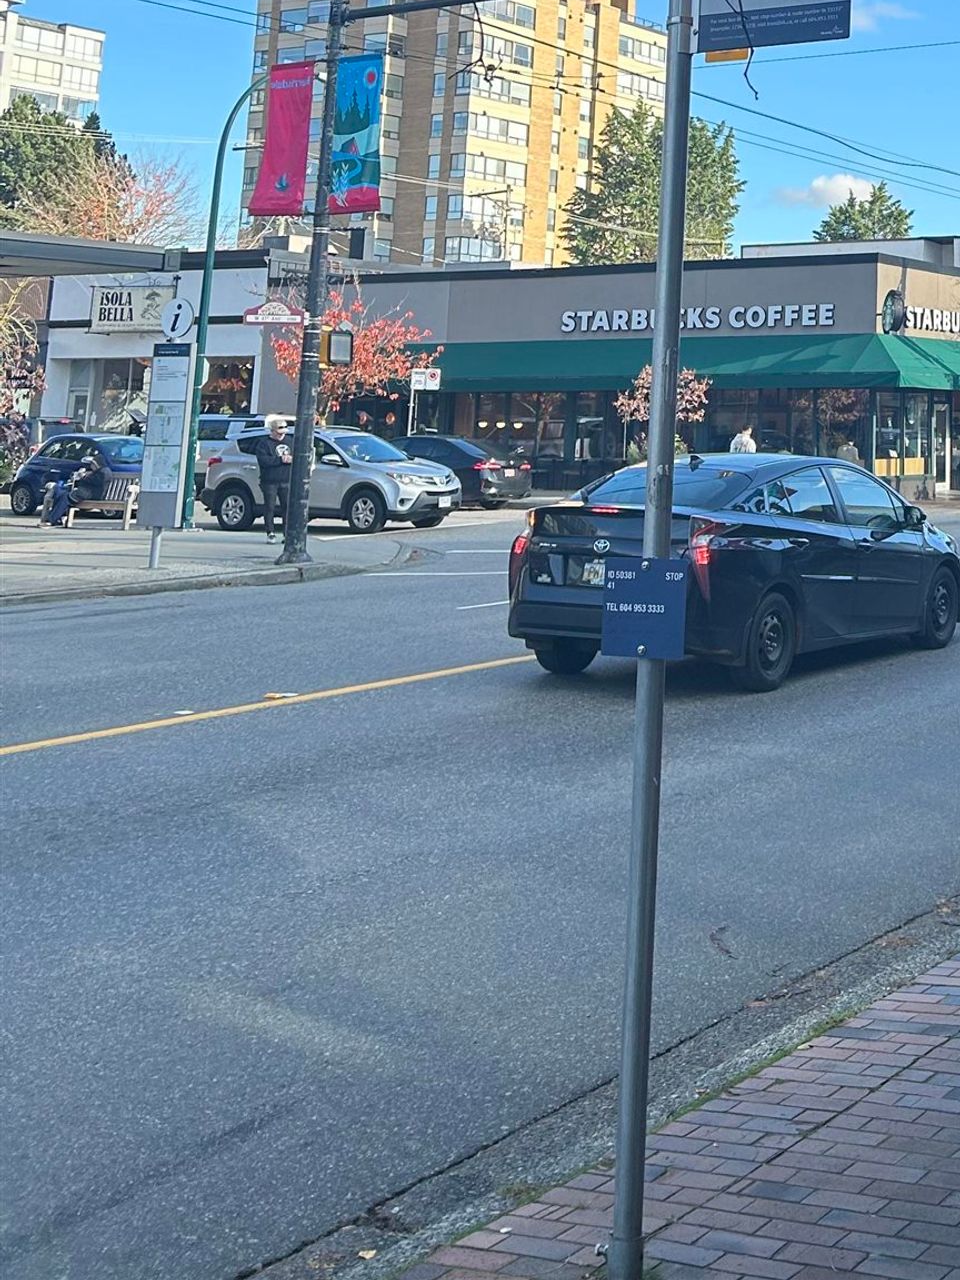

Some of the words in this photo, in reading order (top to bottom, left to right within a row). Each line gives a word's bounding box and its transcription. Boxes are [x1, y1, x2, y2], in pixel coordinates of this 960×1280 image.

[98, 307, 134, 322] BELLA
[728, 303, 835, 328] COFFEE
[607, 571, 615, 579] ID
[615, 571, 636, 580] 50381
[665, 572, 684, 581] STOP
[606, 581, 615, 589] 41
[606, 602, 618, 612] TEL
[619, 603, 633, 613] 604
[633, 604, 647, 613] 953
[647, 604, 665, 613] 3333
